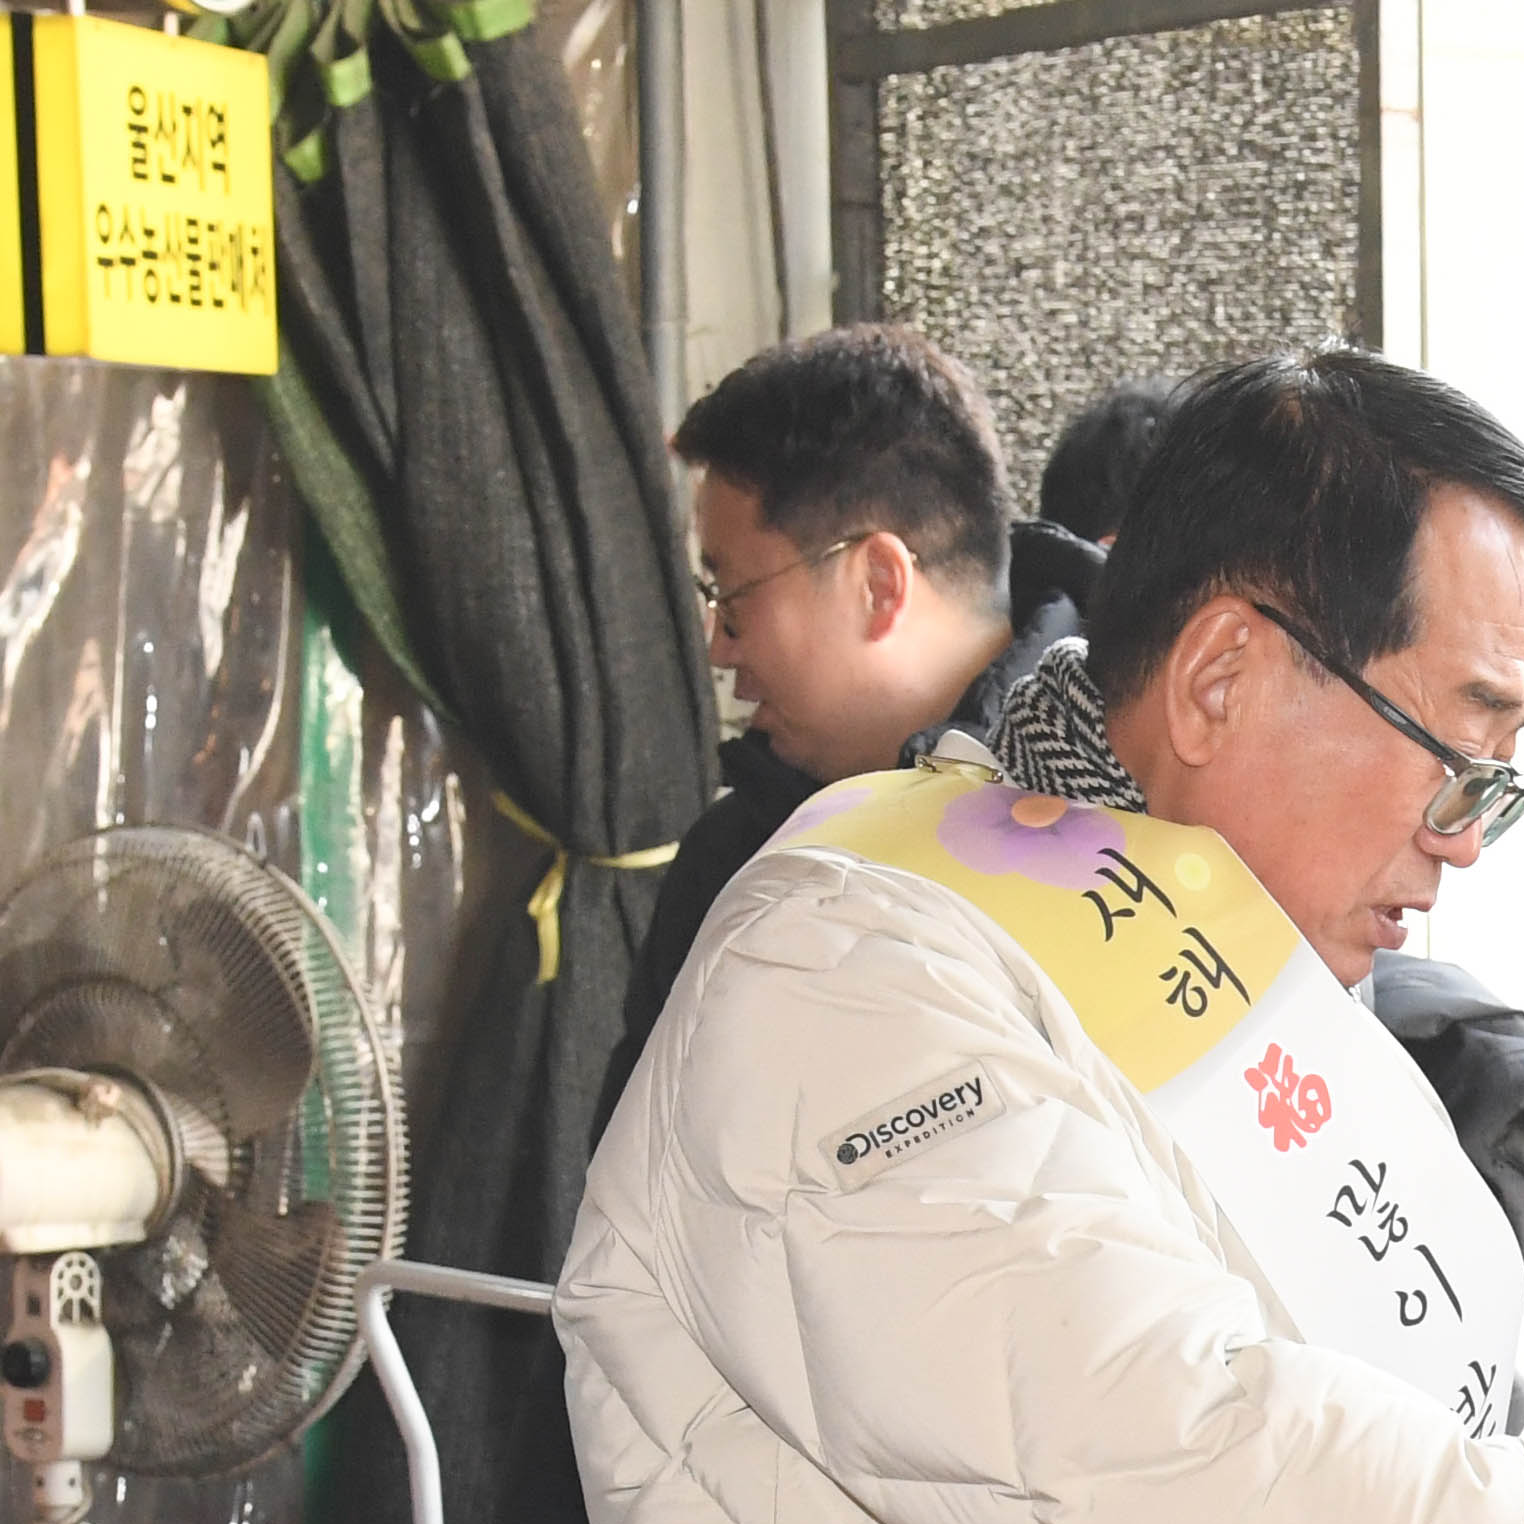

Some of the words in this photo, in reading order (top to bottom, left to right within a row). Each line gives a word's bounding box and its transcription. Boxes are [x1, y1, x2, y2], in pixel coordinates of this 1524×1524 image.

[127, 85, 231, 196] 울산지역
[837, 1076, 983, 1164] Discovery
[885, 1108, 975, 1159] EXPEDITION
[1081, 847, 1252, 1018] 새해
[1244, 1042, 1333, 1153] 福
[1326, 1158, 1464, 1327] 많이
